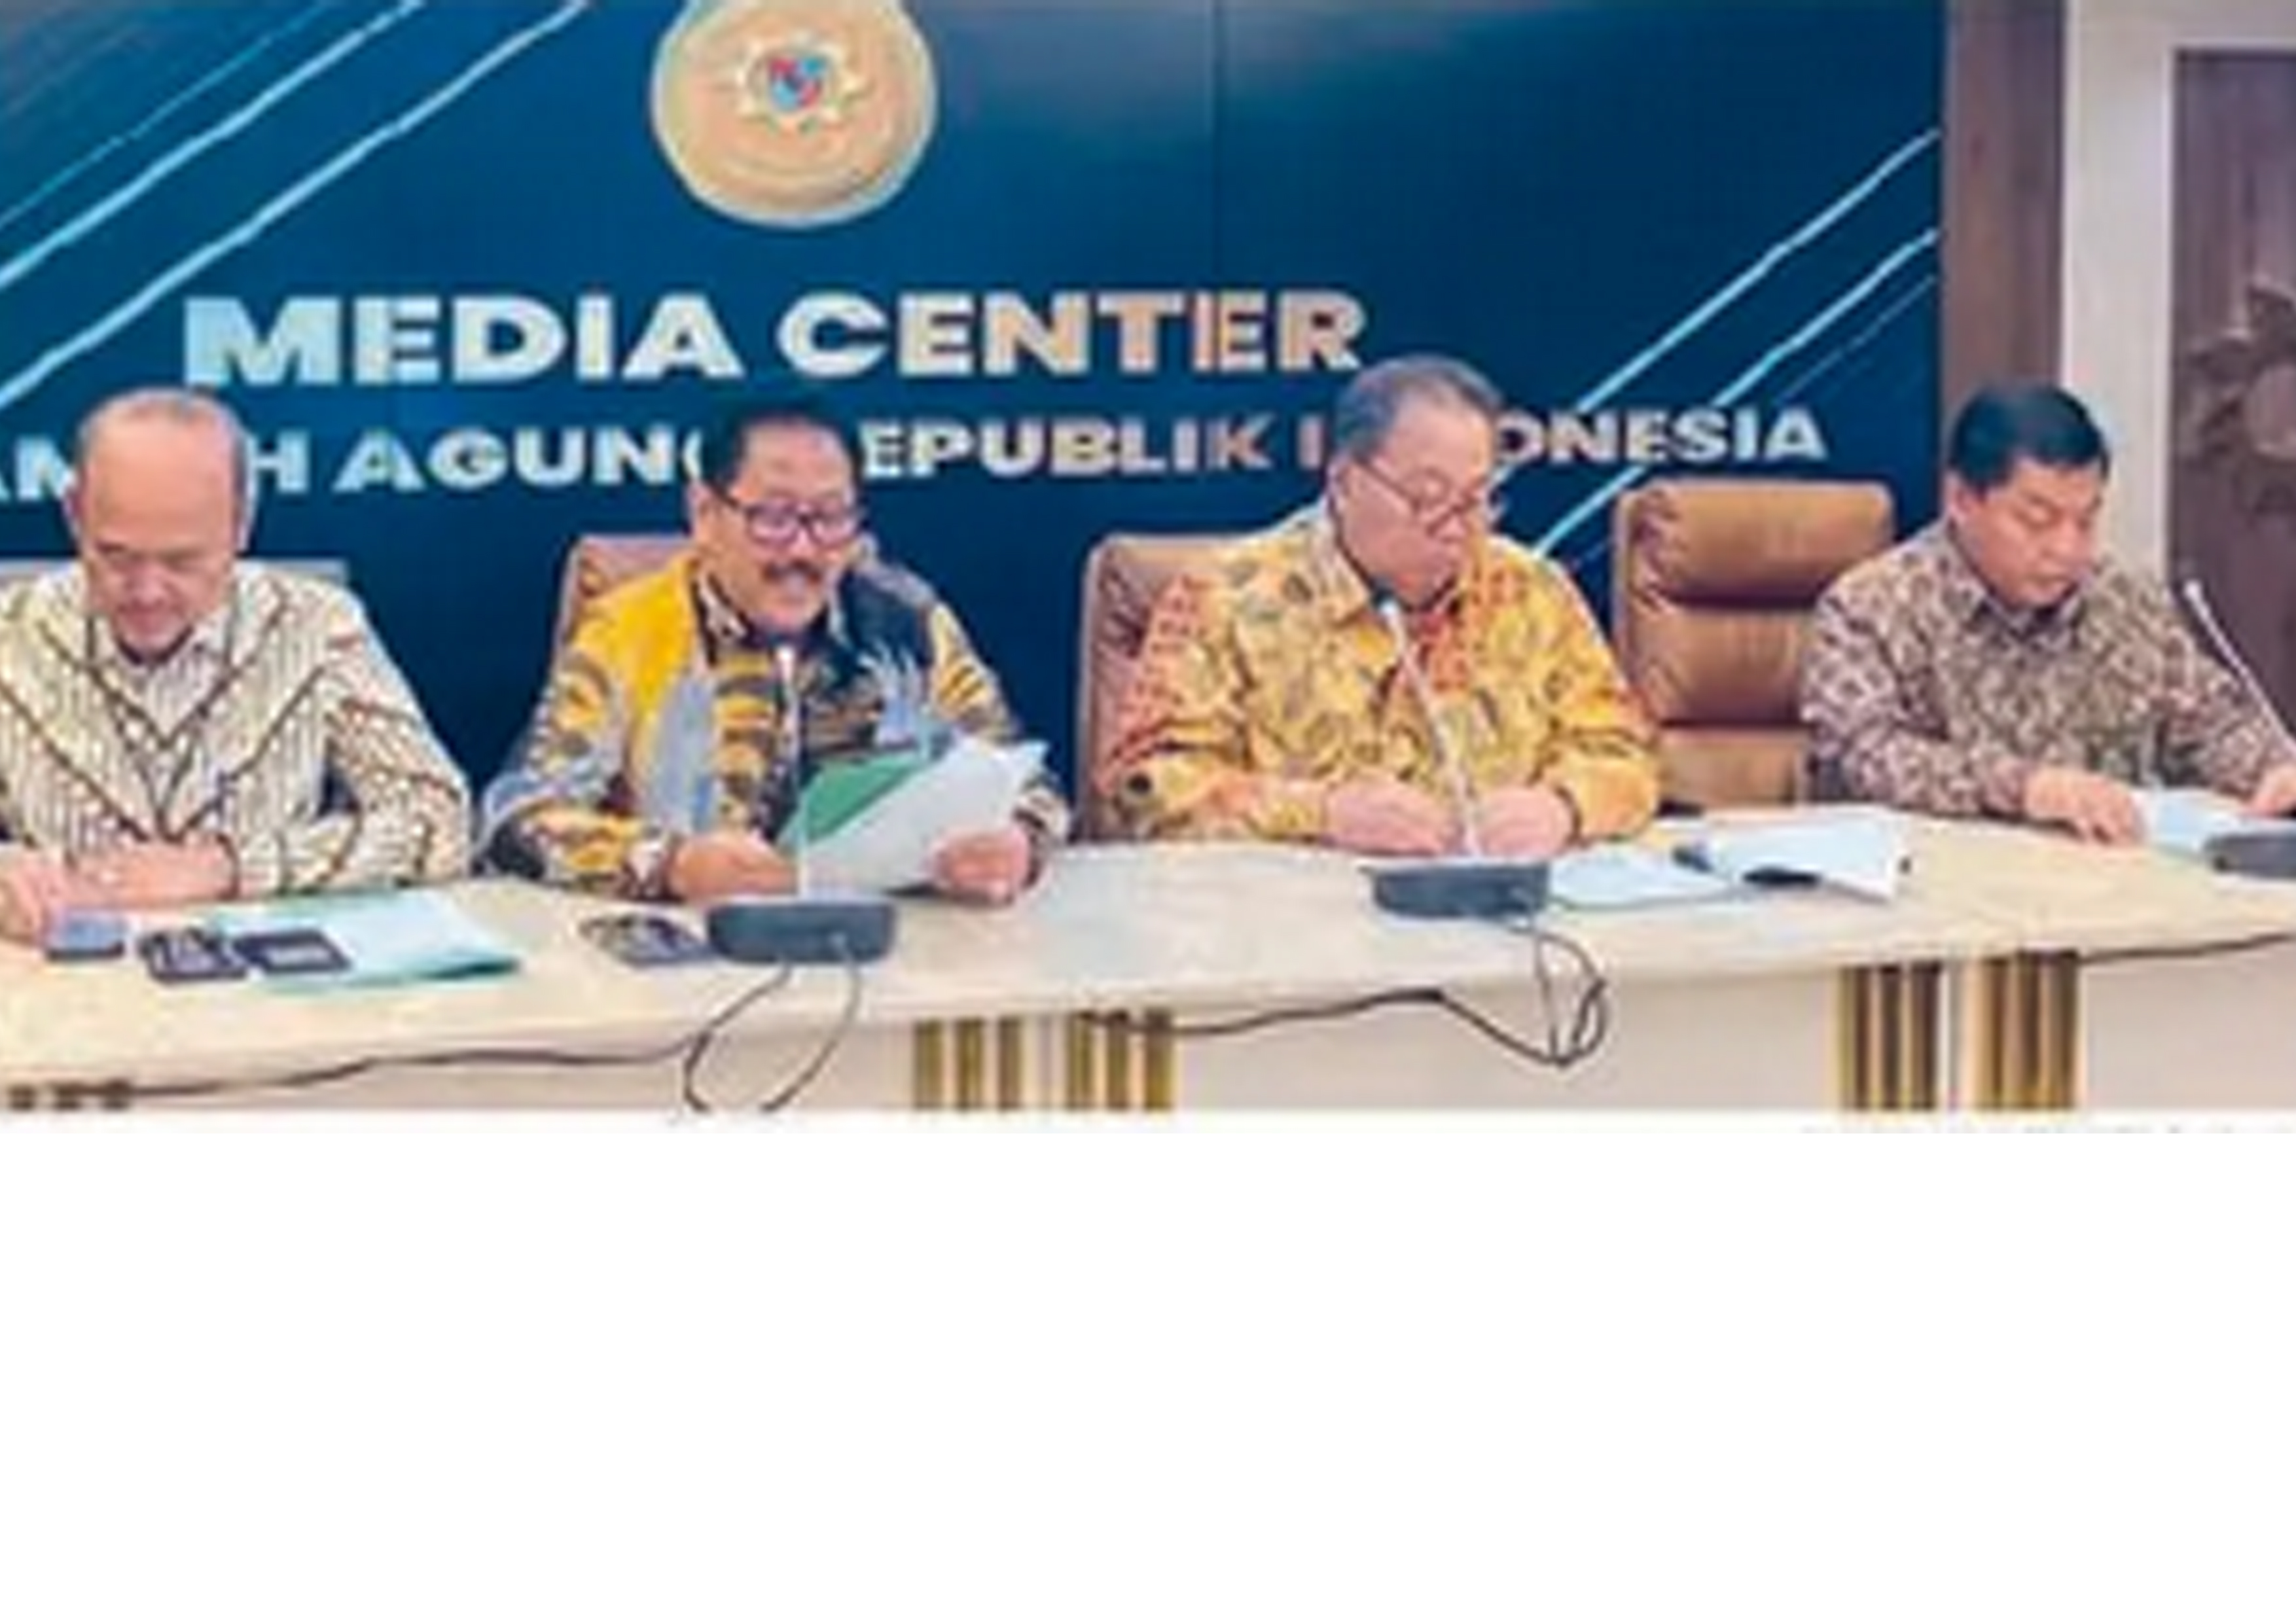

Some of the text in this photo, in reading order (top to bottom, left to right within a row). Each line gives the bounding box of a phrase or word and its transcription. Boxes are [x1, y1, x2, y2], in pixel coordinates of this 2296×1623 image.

[183, 290, 1365, 386] MEDIA CENTER
[0, 406, 1828, 501] MH AGUN EPUBLIK IONESIA
